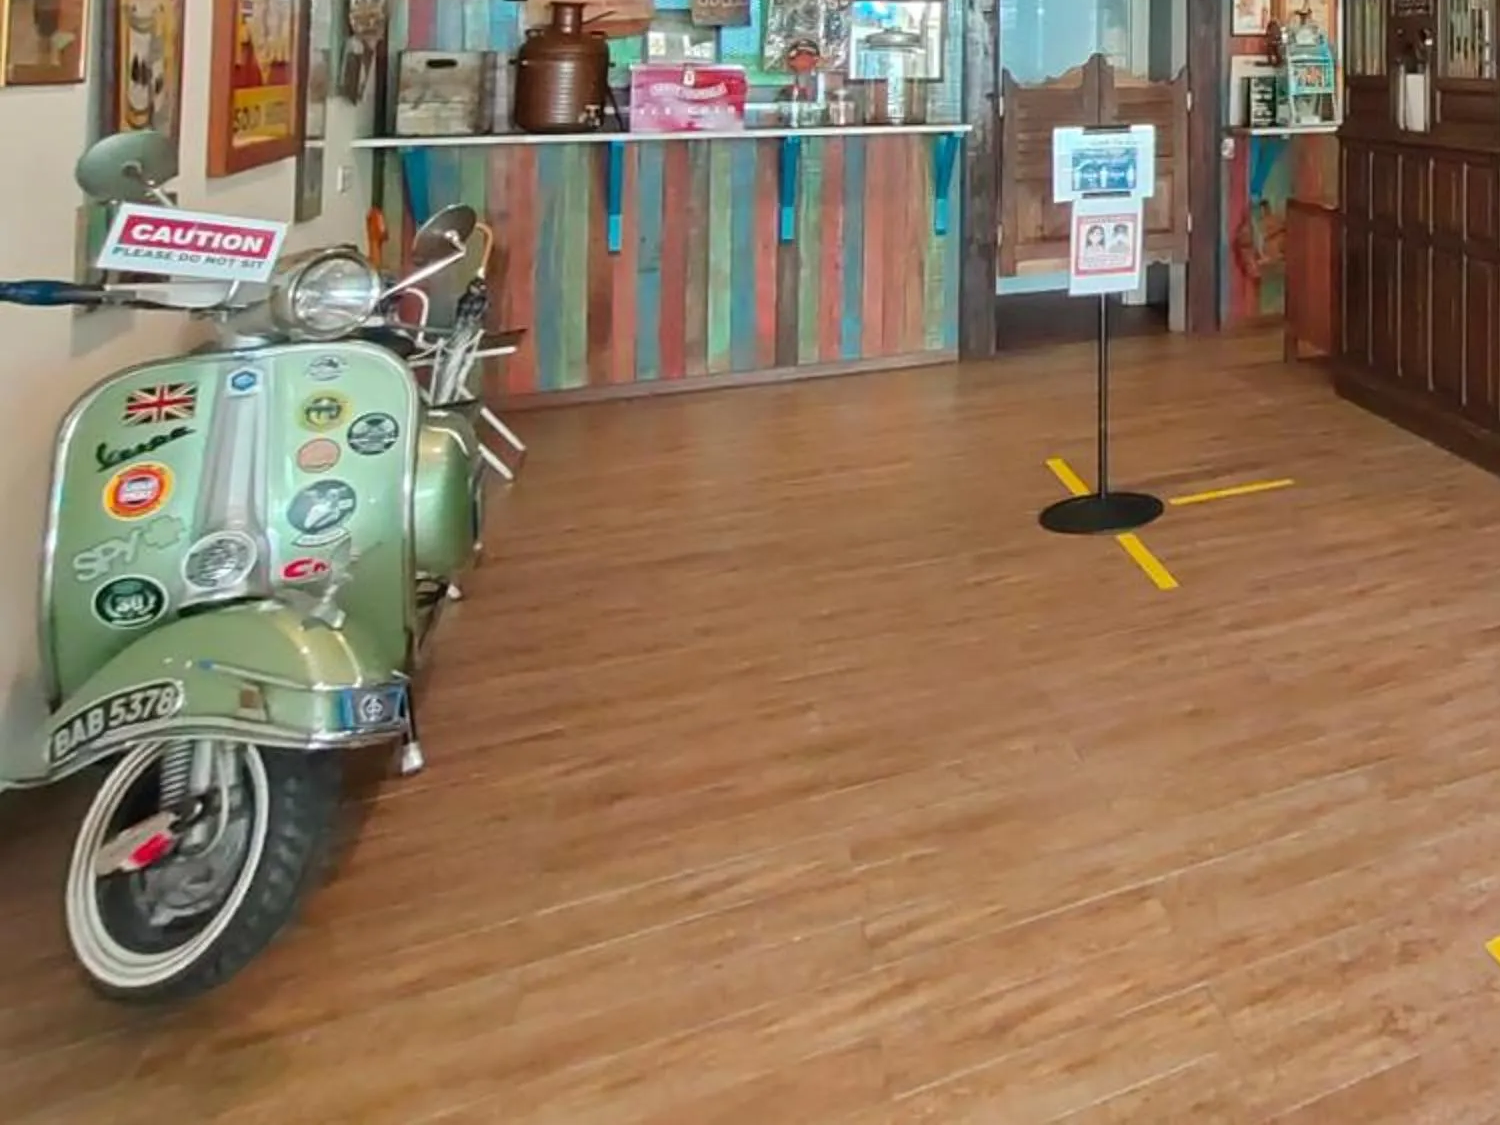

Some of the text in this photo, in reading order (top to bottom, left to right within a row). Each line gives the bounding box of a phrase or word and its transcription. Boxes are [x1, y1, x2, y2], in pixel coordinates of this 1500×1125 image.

[130, 223, 264, 253] CAUTION
[111, 246, 266, 270] PLEASE DO NOT SIT
[54, 685, 176, 759] BAB 5378
